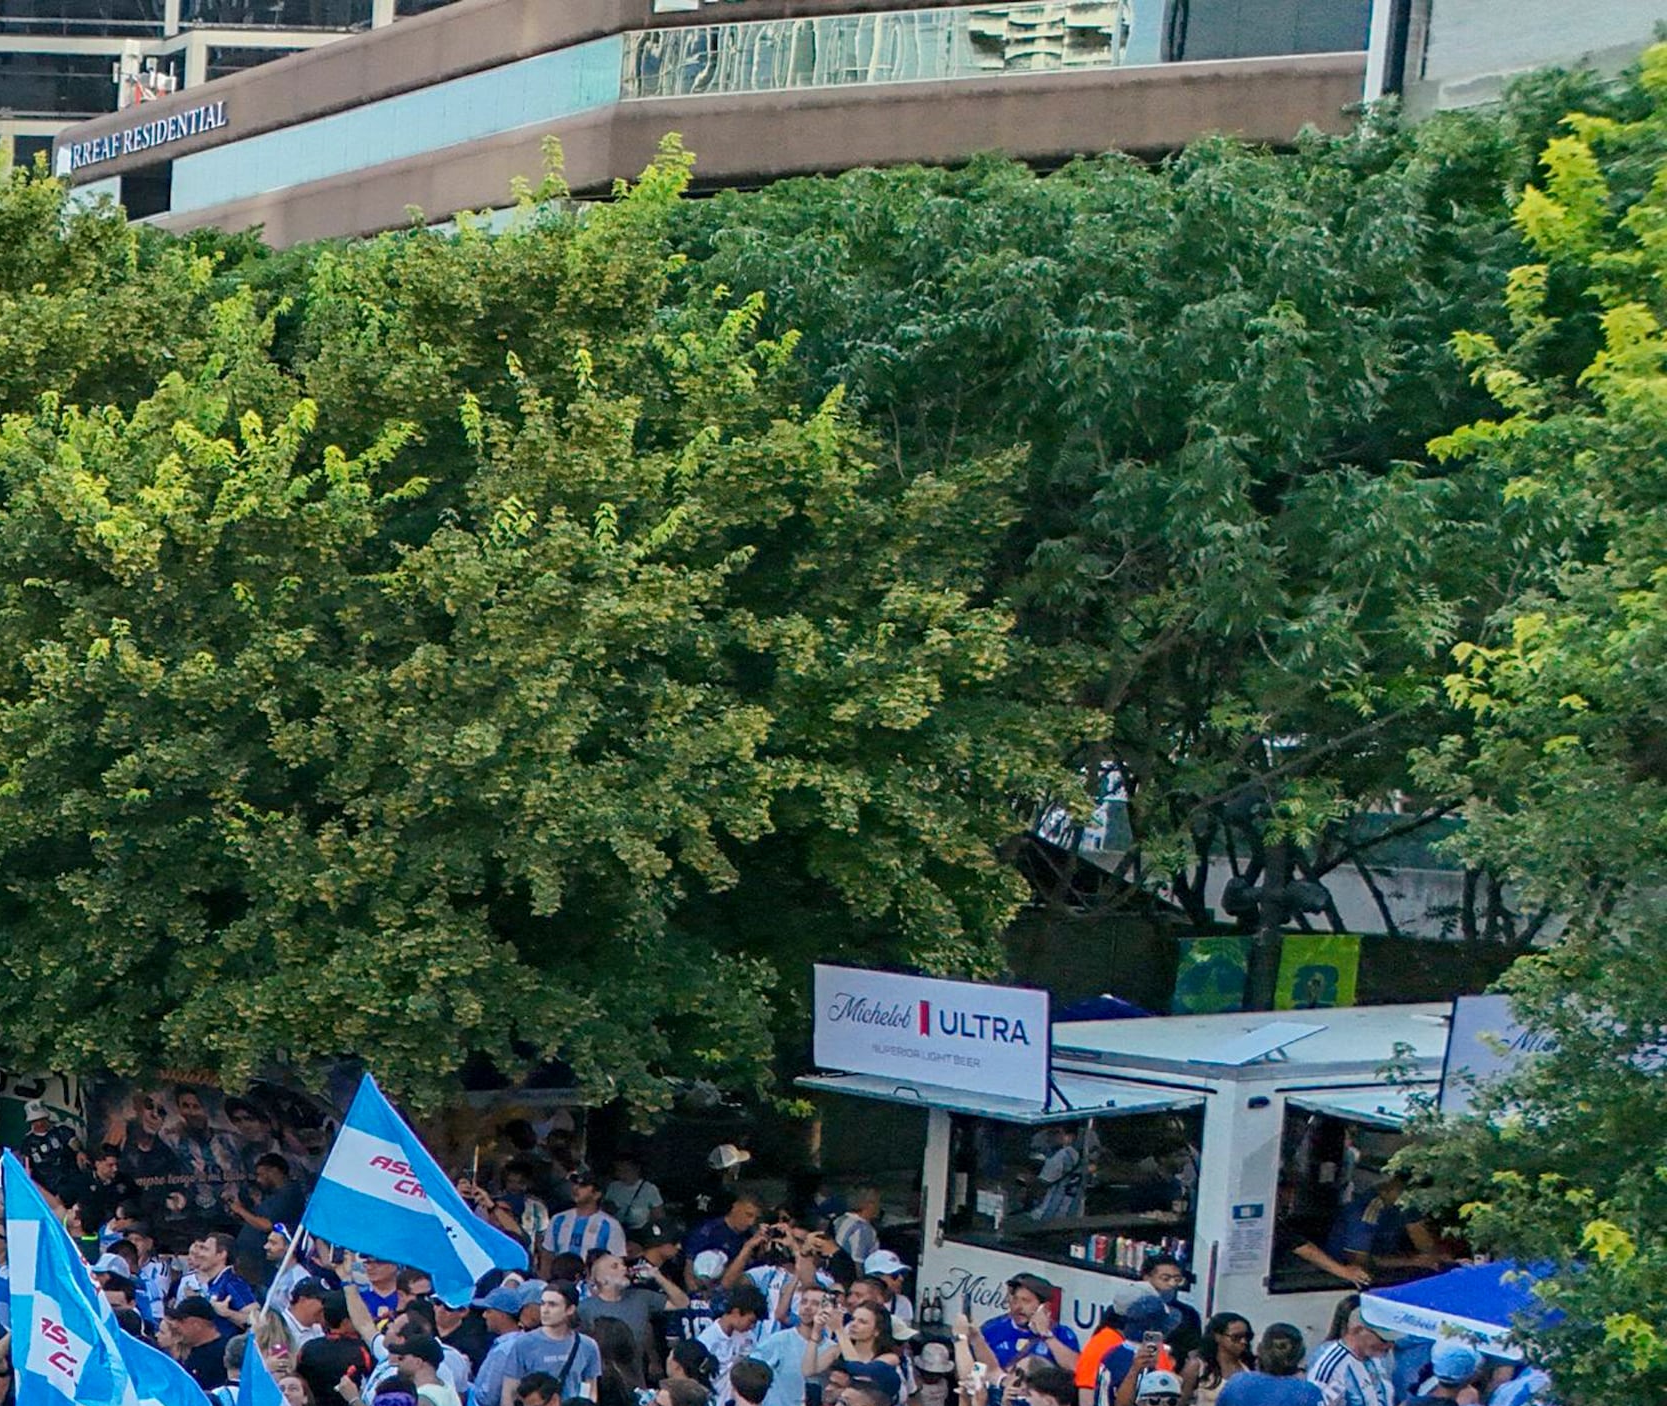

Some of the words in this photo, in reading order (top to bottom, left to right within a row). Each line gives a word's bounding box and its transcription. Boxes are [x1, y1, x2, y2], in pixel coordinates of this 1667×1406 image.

[123, 103, 227, 152] RESIDENTIAL
[829, 991, 912, 1033] Michelob
[939, 1012, 1030, 1046] ULTRA
[954, 1054, 982, 1068] BEER
[940, 1267, 1009, 1308] Miche
